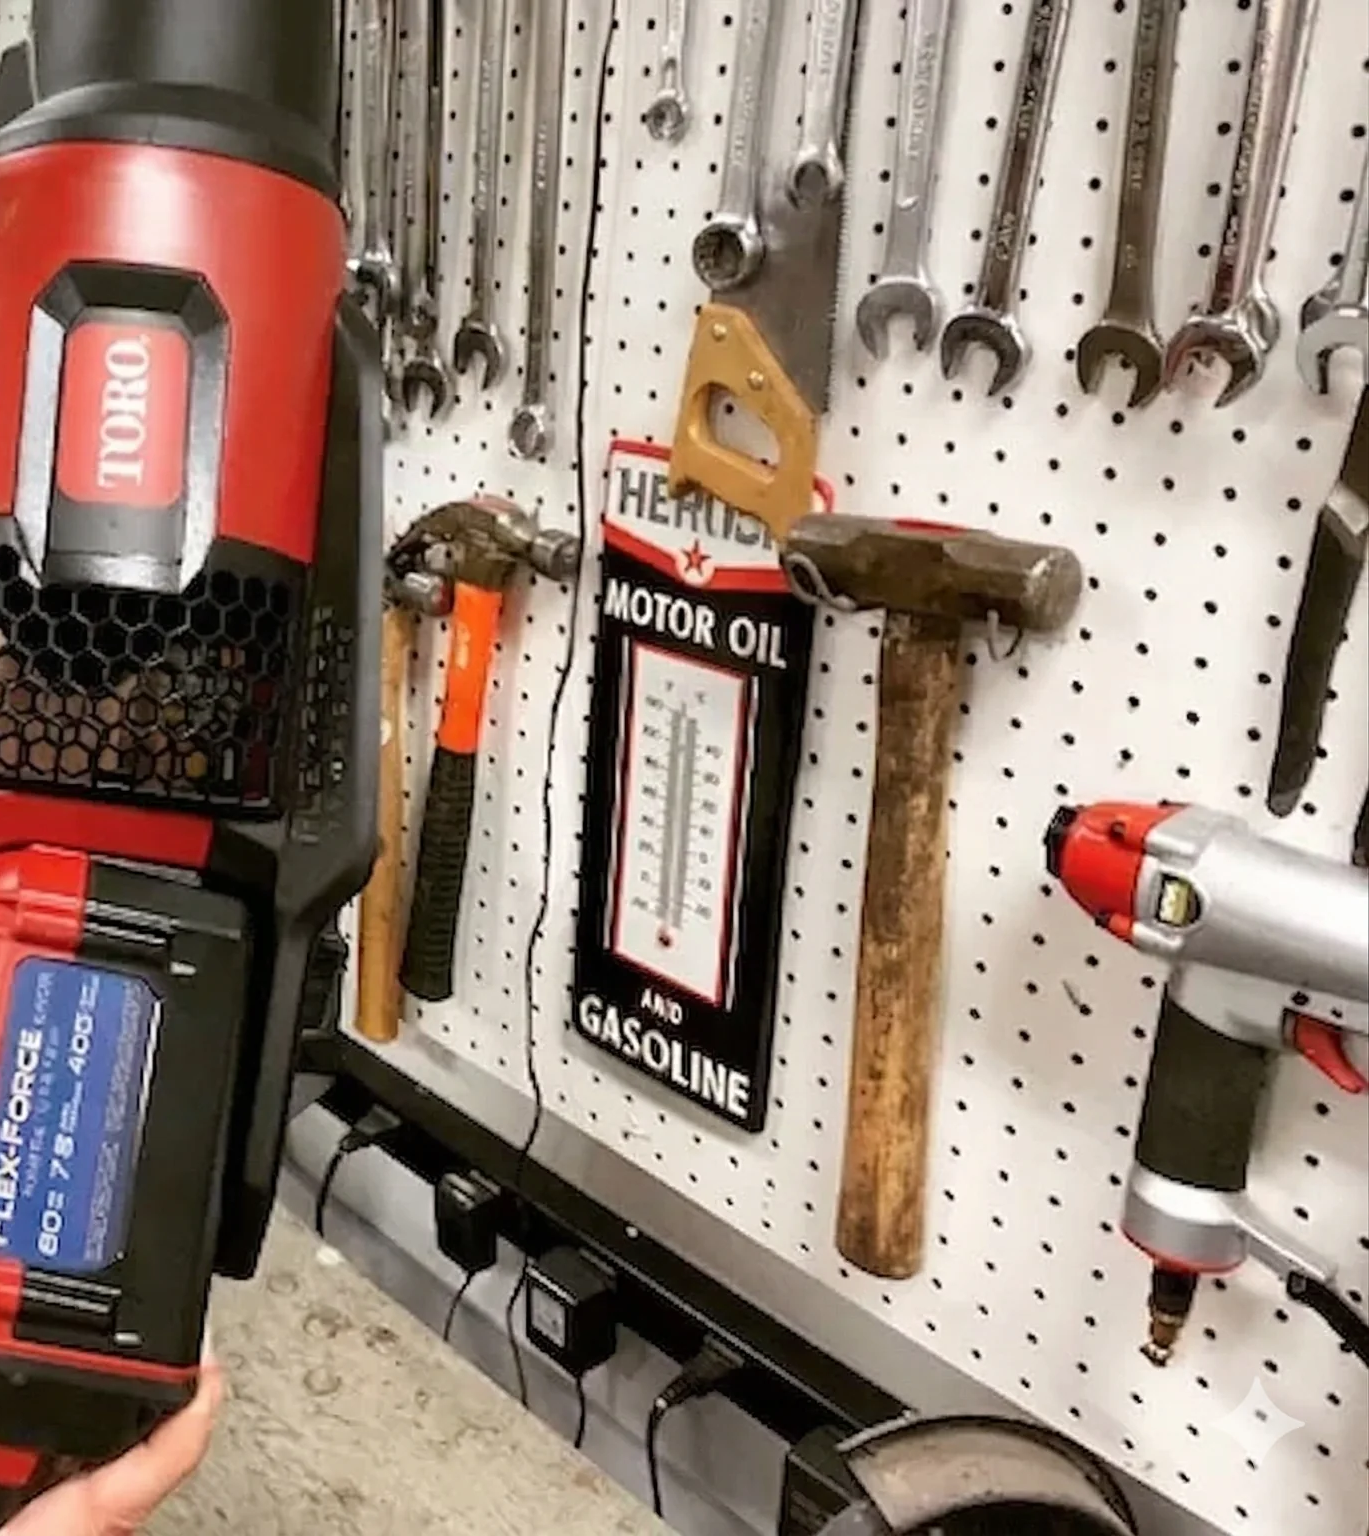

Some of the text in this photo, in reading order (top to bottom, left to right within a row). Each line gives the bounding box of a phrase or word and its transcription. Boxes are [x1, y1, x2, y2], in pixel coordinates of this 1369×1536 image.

[97, 339, 150, 488] TORO
[604, 577, 787, 669] MOTOR OIL
[580, 994, 750, 1119] GASOLINE
[640, 988, 683, 1026] AND
